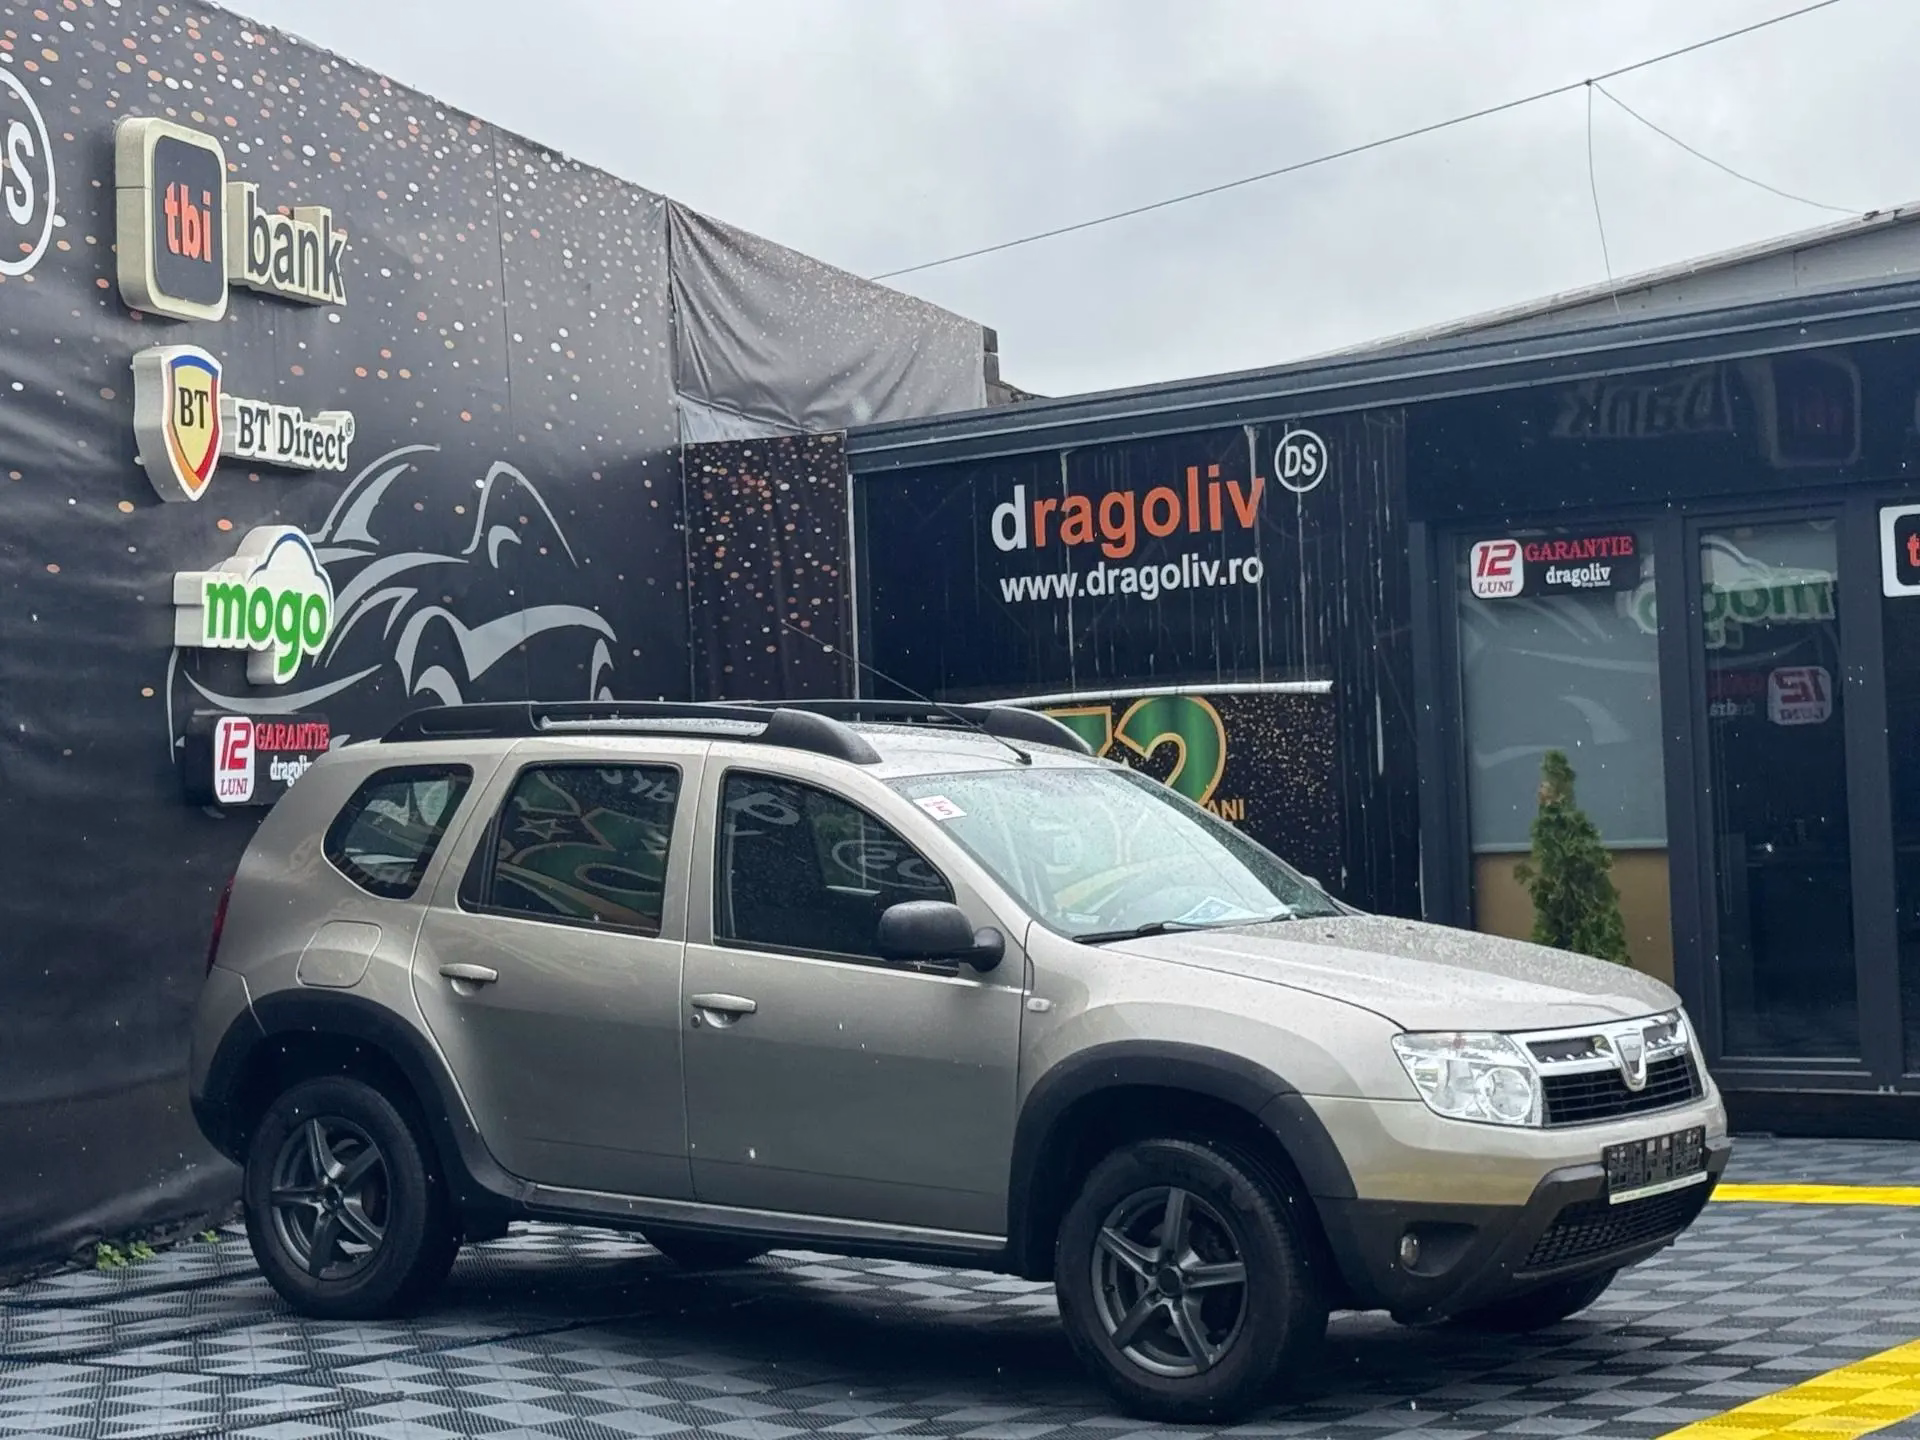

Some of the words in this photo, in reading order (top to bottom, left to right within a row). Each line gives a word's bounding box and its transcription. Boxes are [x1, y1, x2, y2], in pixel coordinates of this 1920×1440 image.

[0, 121, 35, 225] S
[164, 181, 212, 262] tbi
[247, 189, 346, 300] bank
[178, 386, 209, 430] BT
[238, 406, 270, 451] BT
[1284, 442, 1318, 478] DS
[991, 464, 1265, 559] dragoliv
[1000, 553, 1264, 602] www.dragoliv.ro
[1477, 543, 1516, 577] 12
[1523, 536, 1633, 562] GARANTIE
[1545, 562, 1612, 587] dragoliv
[1478, 580, 1513, 594] LUNI
[205, 582, 327, 676] mogo
[220, 722, 251, 771] 12
[255, 723, 330, 751] GARANTIE
[220, 778, 248, 796] LUNI
